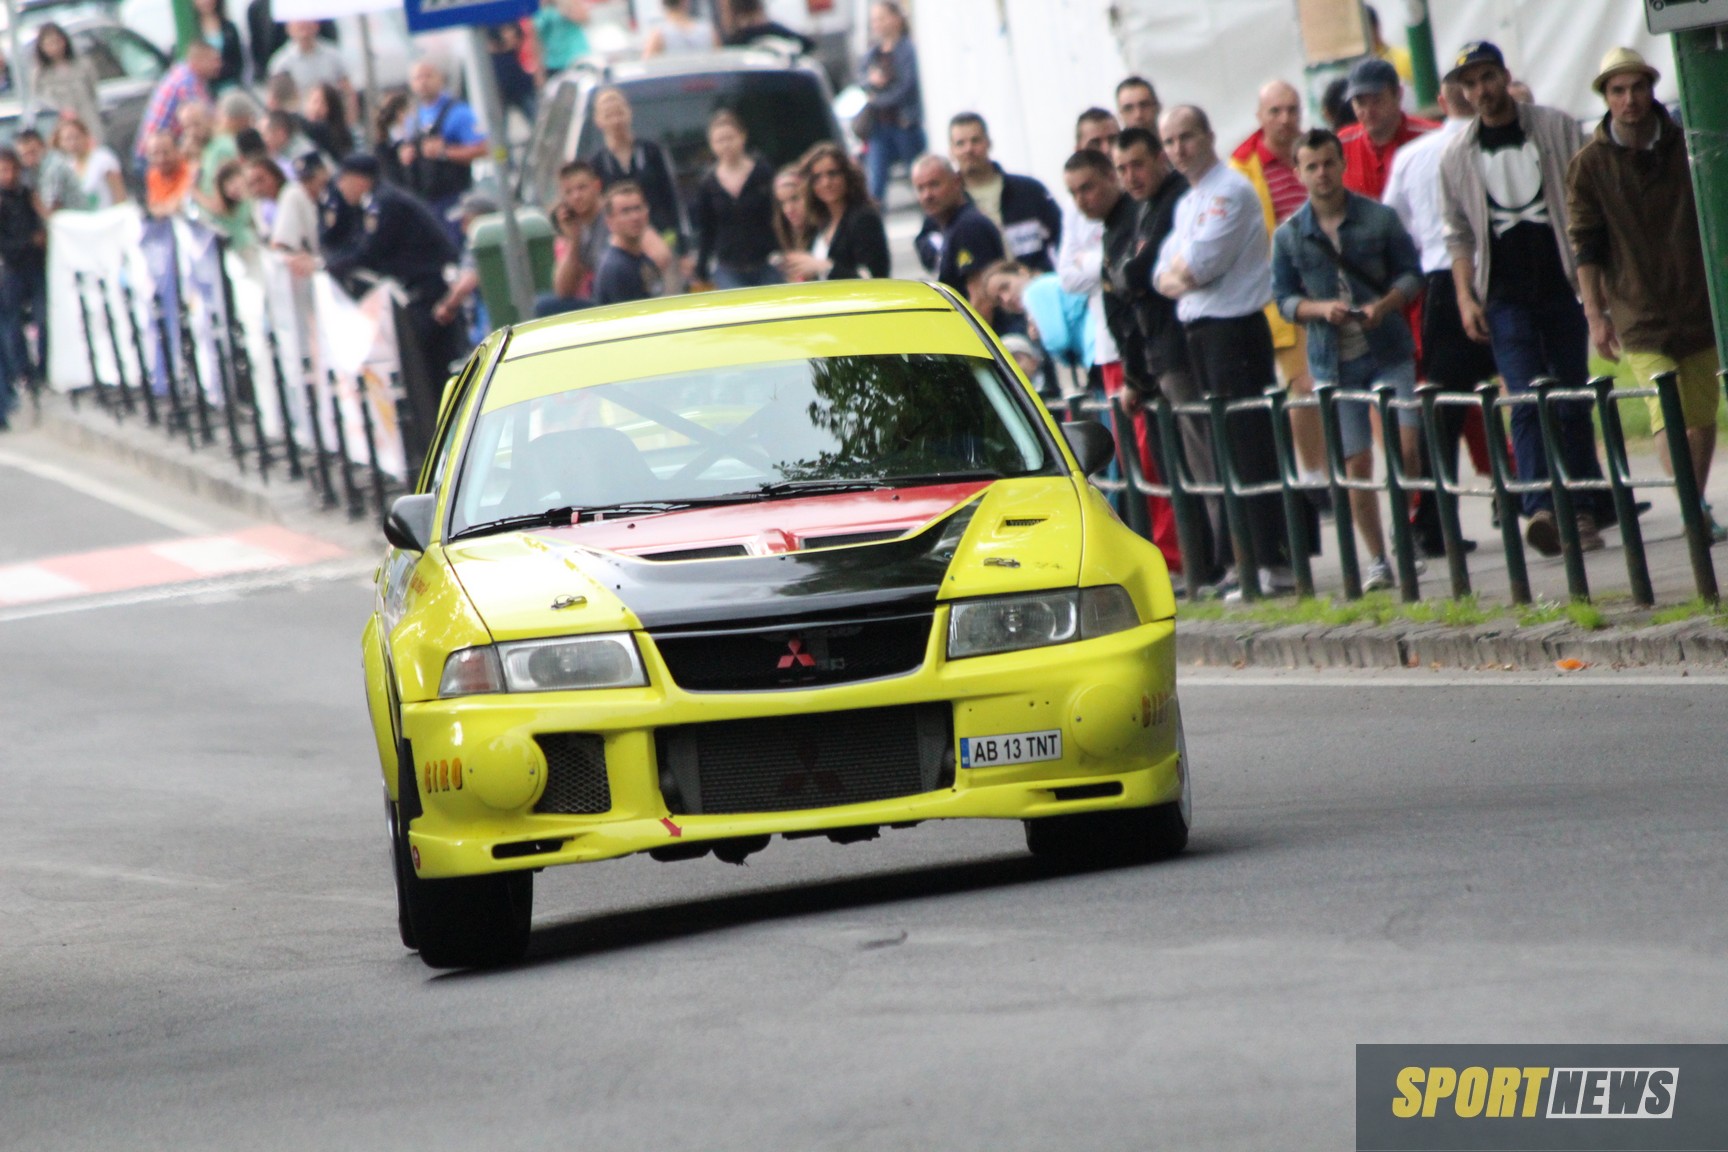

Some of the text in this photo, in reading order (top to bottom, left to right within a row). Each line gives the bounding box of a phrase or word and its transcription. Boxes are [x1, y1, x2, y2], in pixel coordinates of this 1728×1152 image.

[974, 734, 1058, 763] AB 13 TNT
